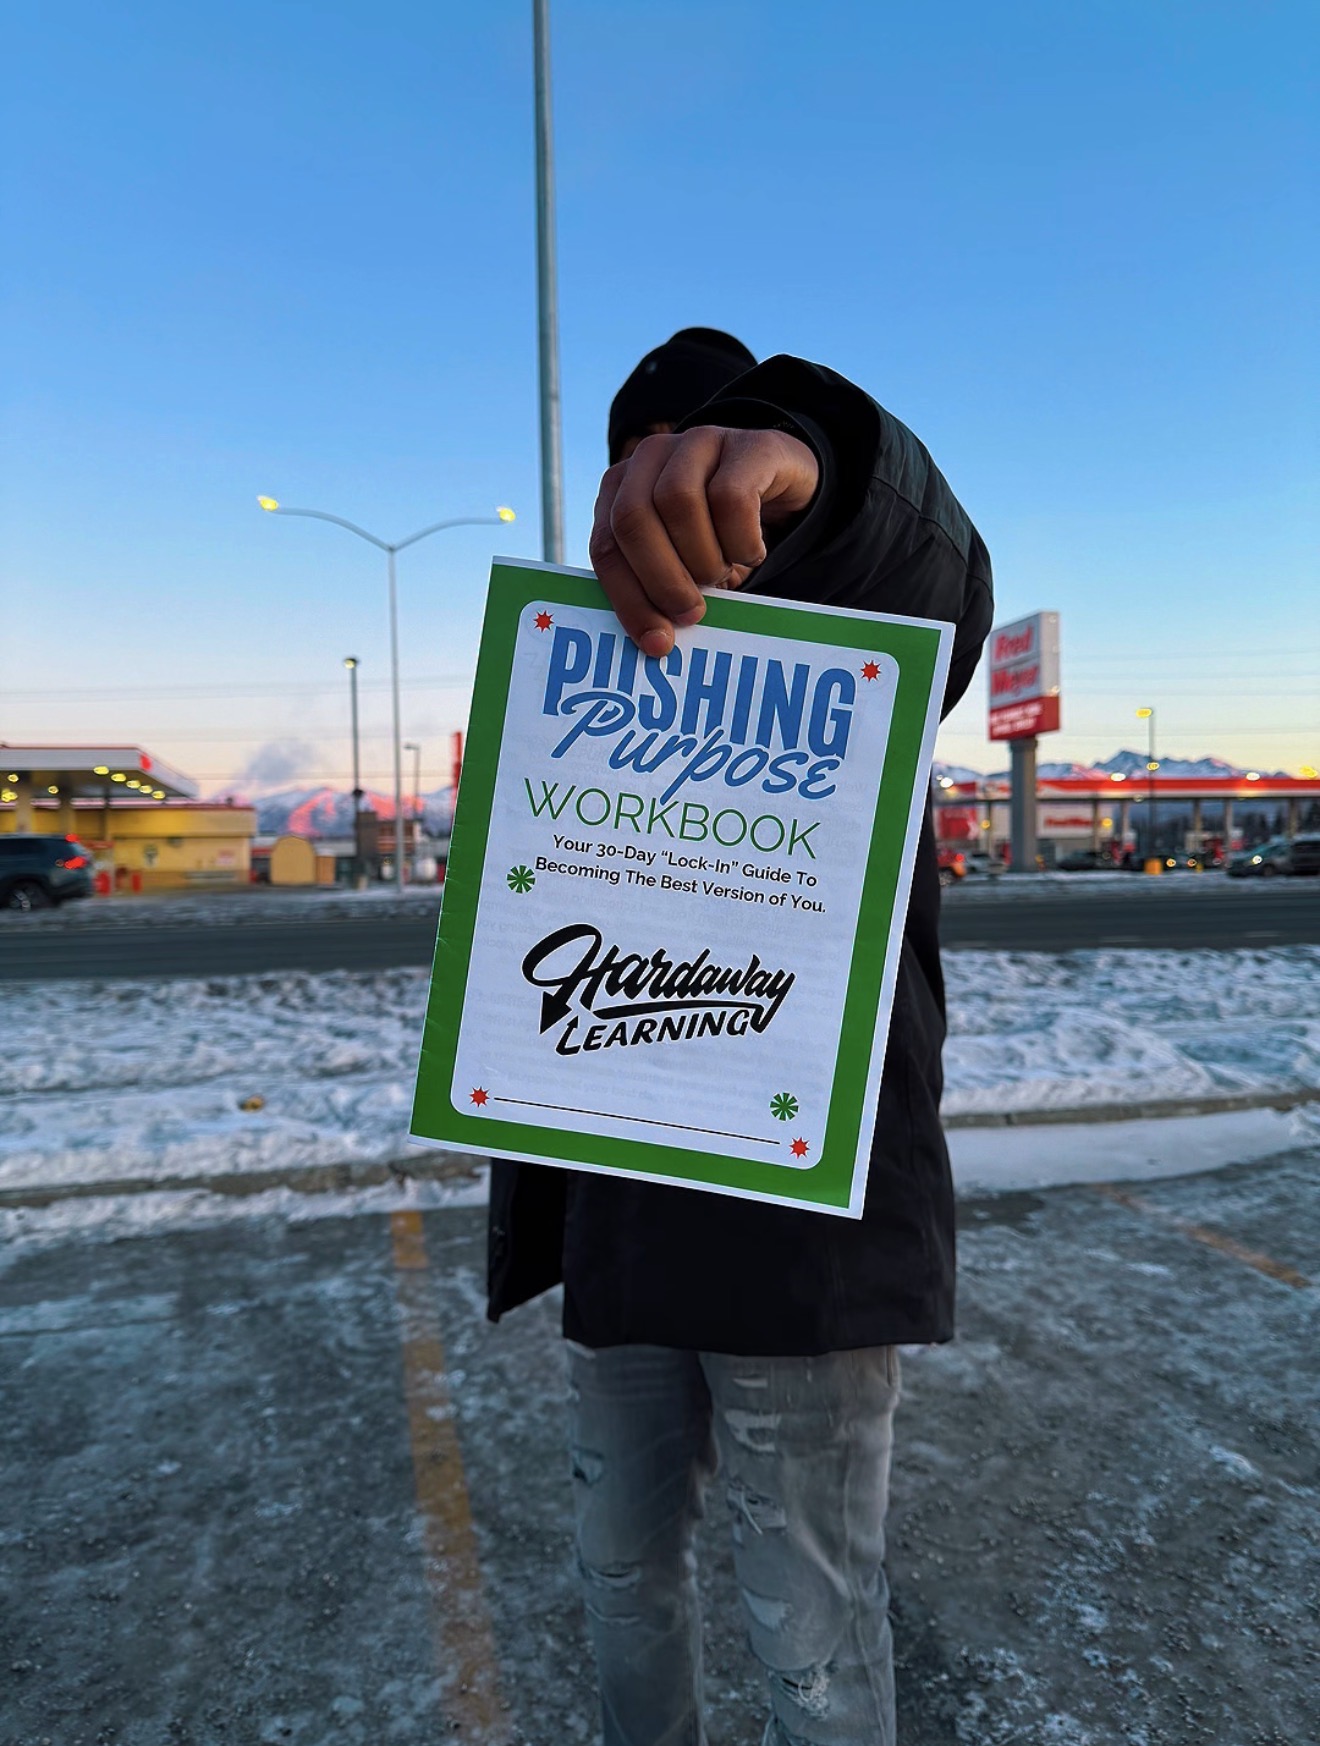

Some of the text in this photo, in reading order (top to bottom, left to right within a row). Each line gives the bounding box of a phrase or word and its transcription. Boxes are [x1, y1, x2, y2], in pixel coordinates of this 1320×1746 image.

[543, 626, 856, 760] PUSHING
[551, 691, 840, 805] Purpose
[524, 778, 821, 859] WORKBOOK
[535, 856, 827, 913] Becoming The Best Version of You.
[552, 834, 818, 887] Your 30-Day “Lock-In” Guide To
[522, 923, 795, 1034] Hardaway
[555, 1008, 750, 1056] LEARNING
